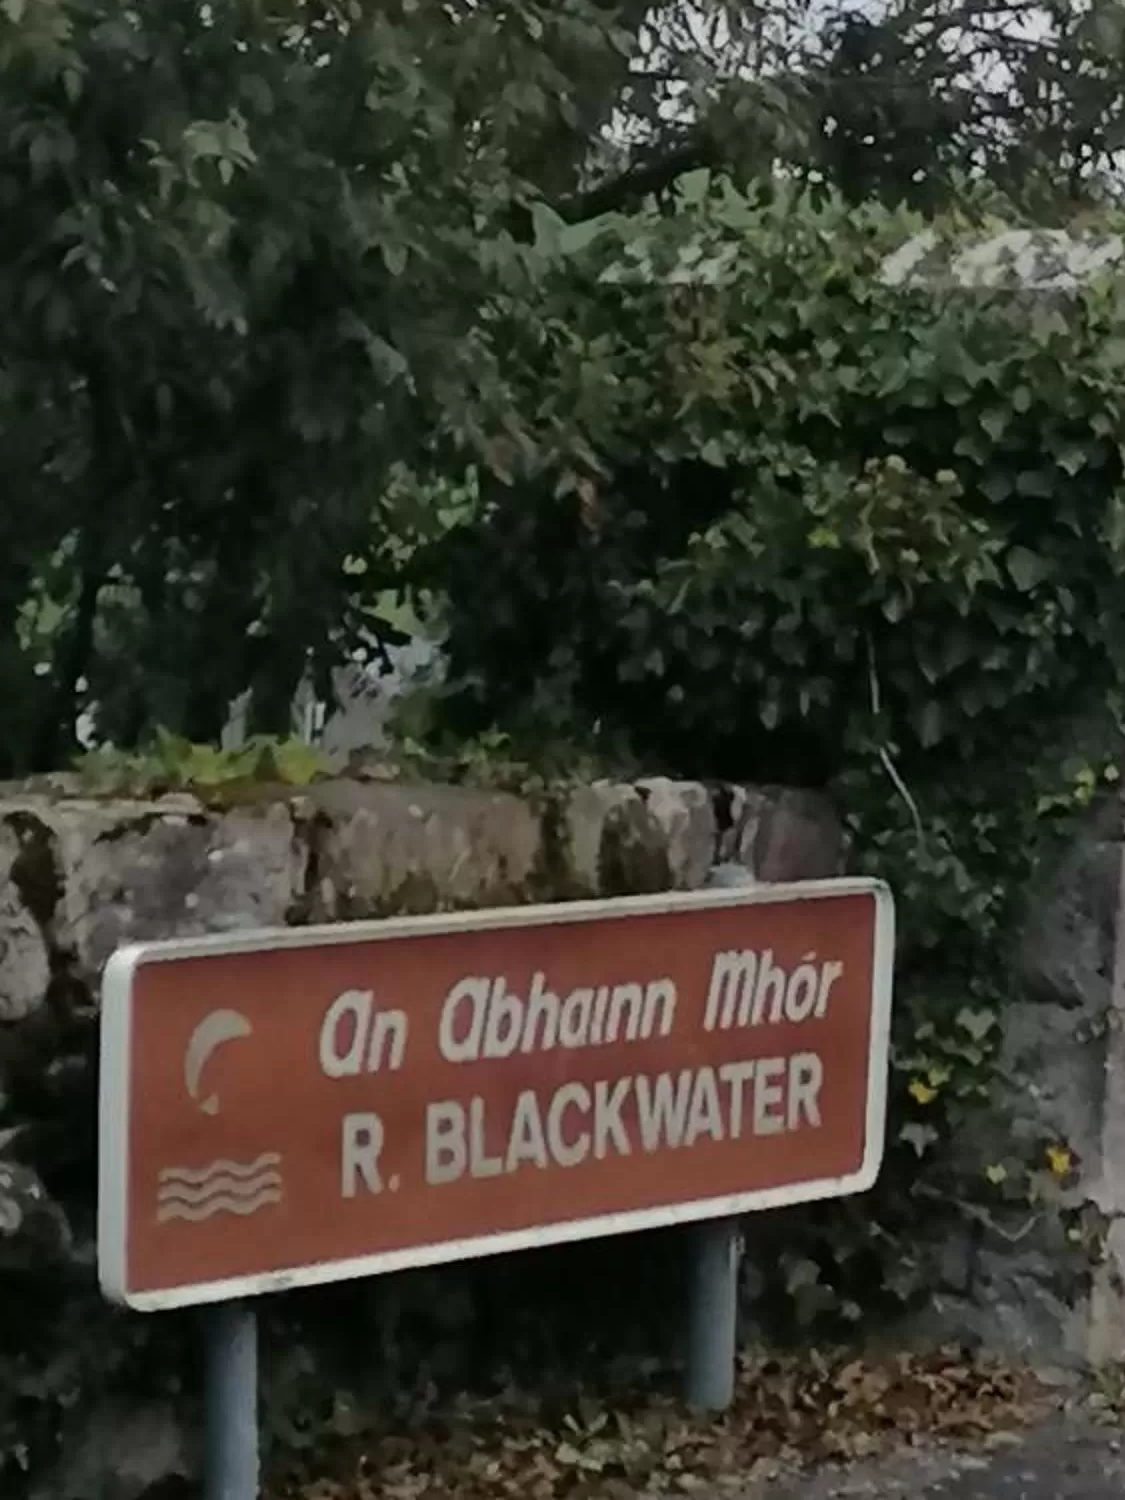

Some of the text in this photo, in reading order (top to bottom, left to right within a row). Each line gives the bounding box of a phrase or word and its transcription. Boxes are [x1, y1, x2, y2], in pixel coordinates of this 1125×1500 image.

[319, 990, 408, 1077] An
[704, 949, 843, 1031] Mhór
[341, 1052, 822, 1197] R. BLACKWATER
